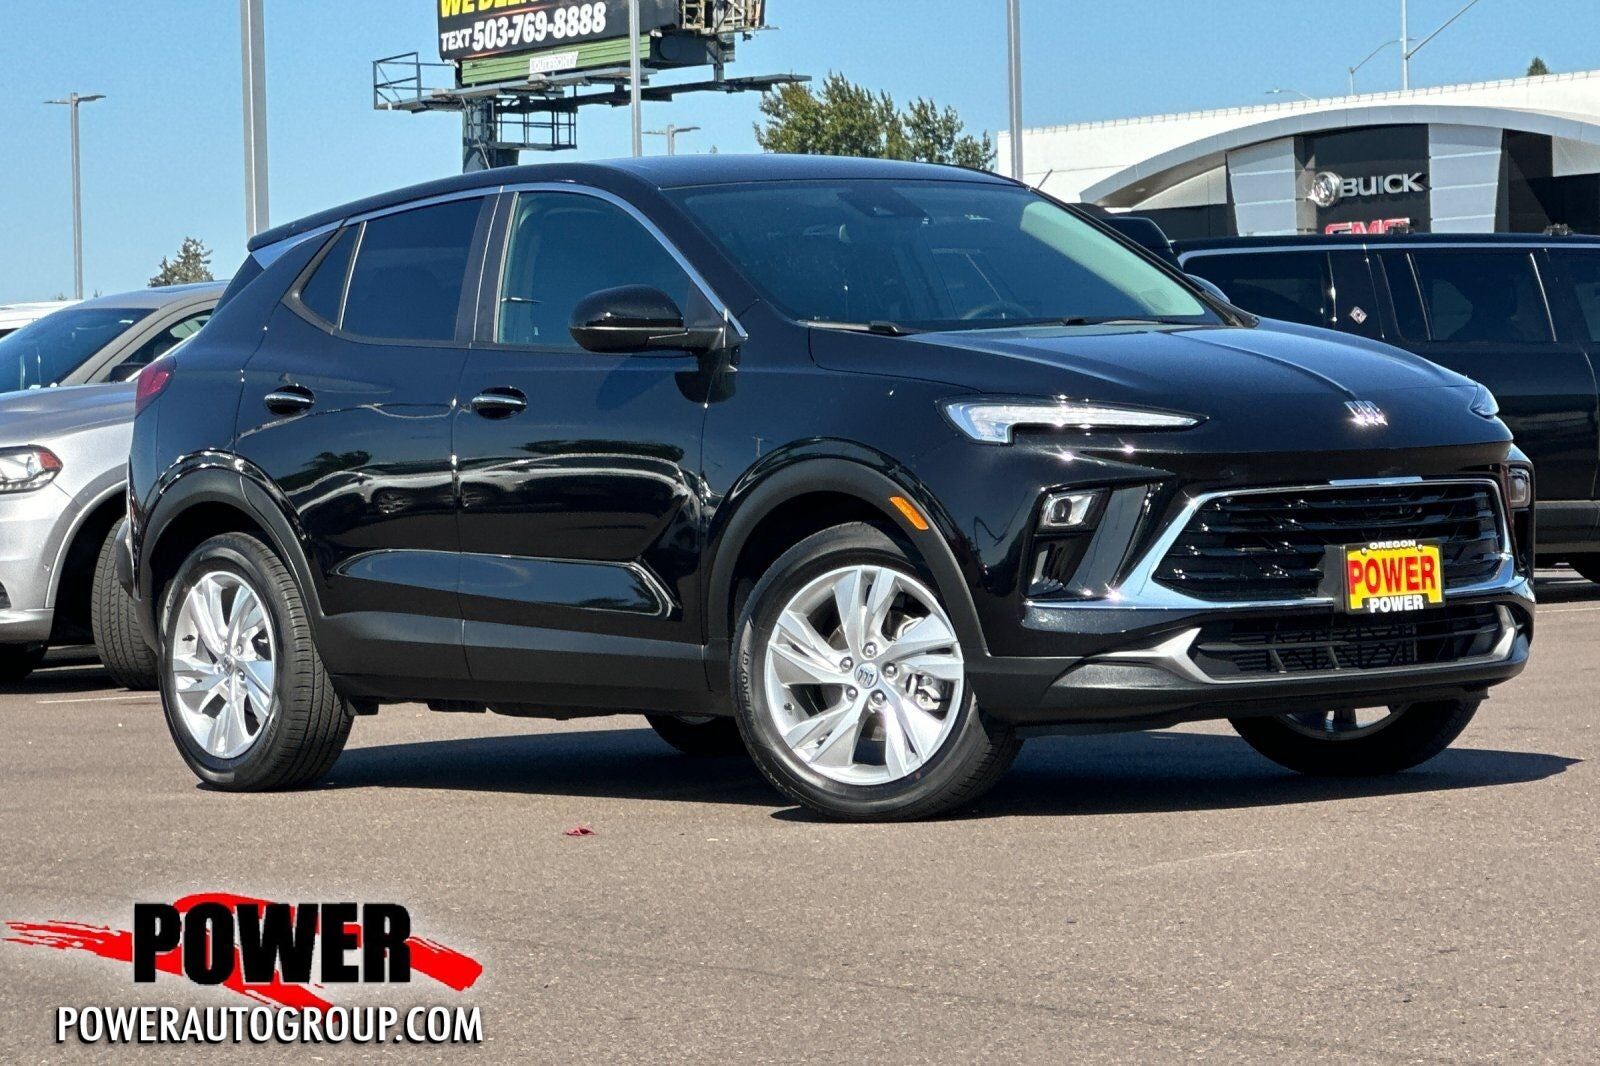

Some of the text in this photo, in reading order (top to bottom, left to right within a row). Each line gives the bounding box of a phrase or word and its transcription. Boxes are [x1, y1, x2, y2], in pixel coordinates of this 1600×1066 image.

[440, 2, 607, 52] TEXT 503-769-8888
[1340, 172, 1424, 198] BUICK
[1369, 539, 1416, 551] OREGON
[1348, 555, 1436, 595] POWER
[1368, 594, 1424, 613] POWER
